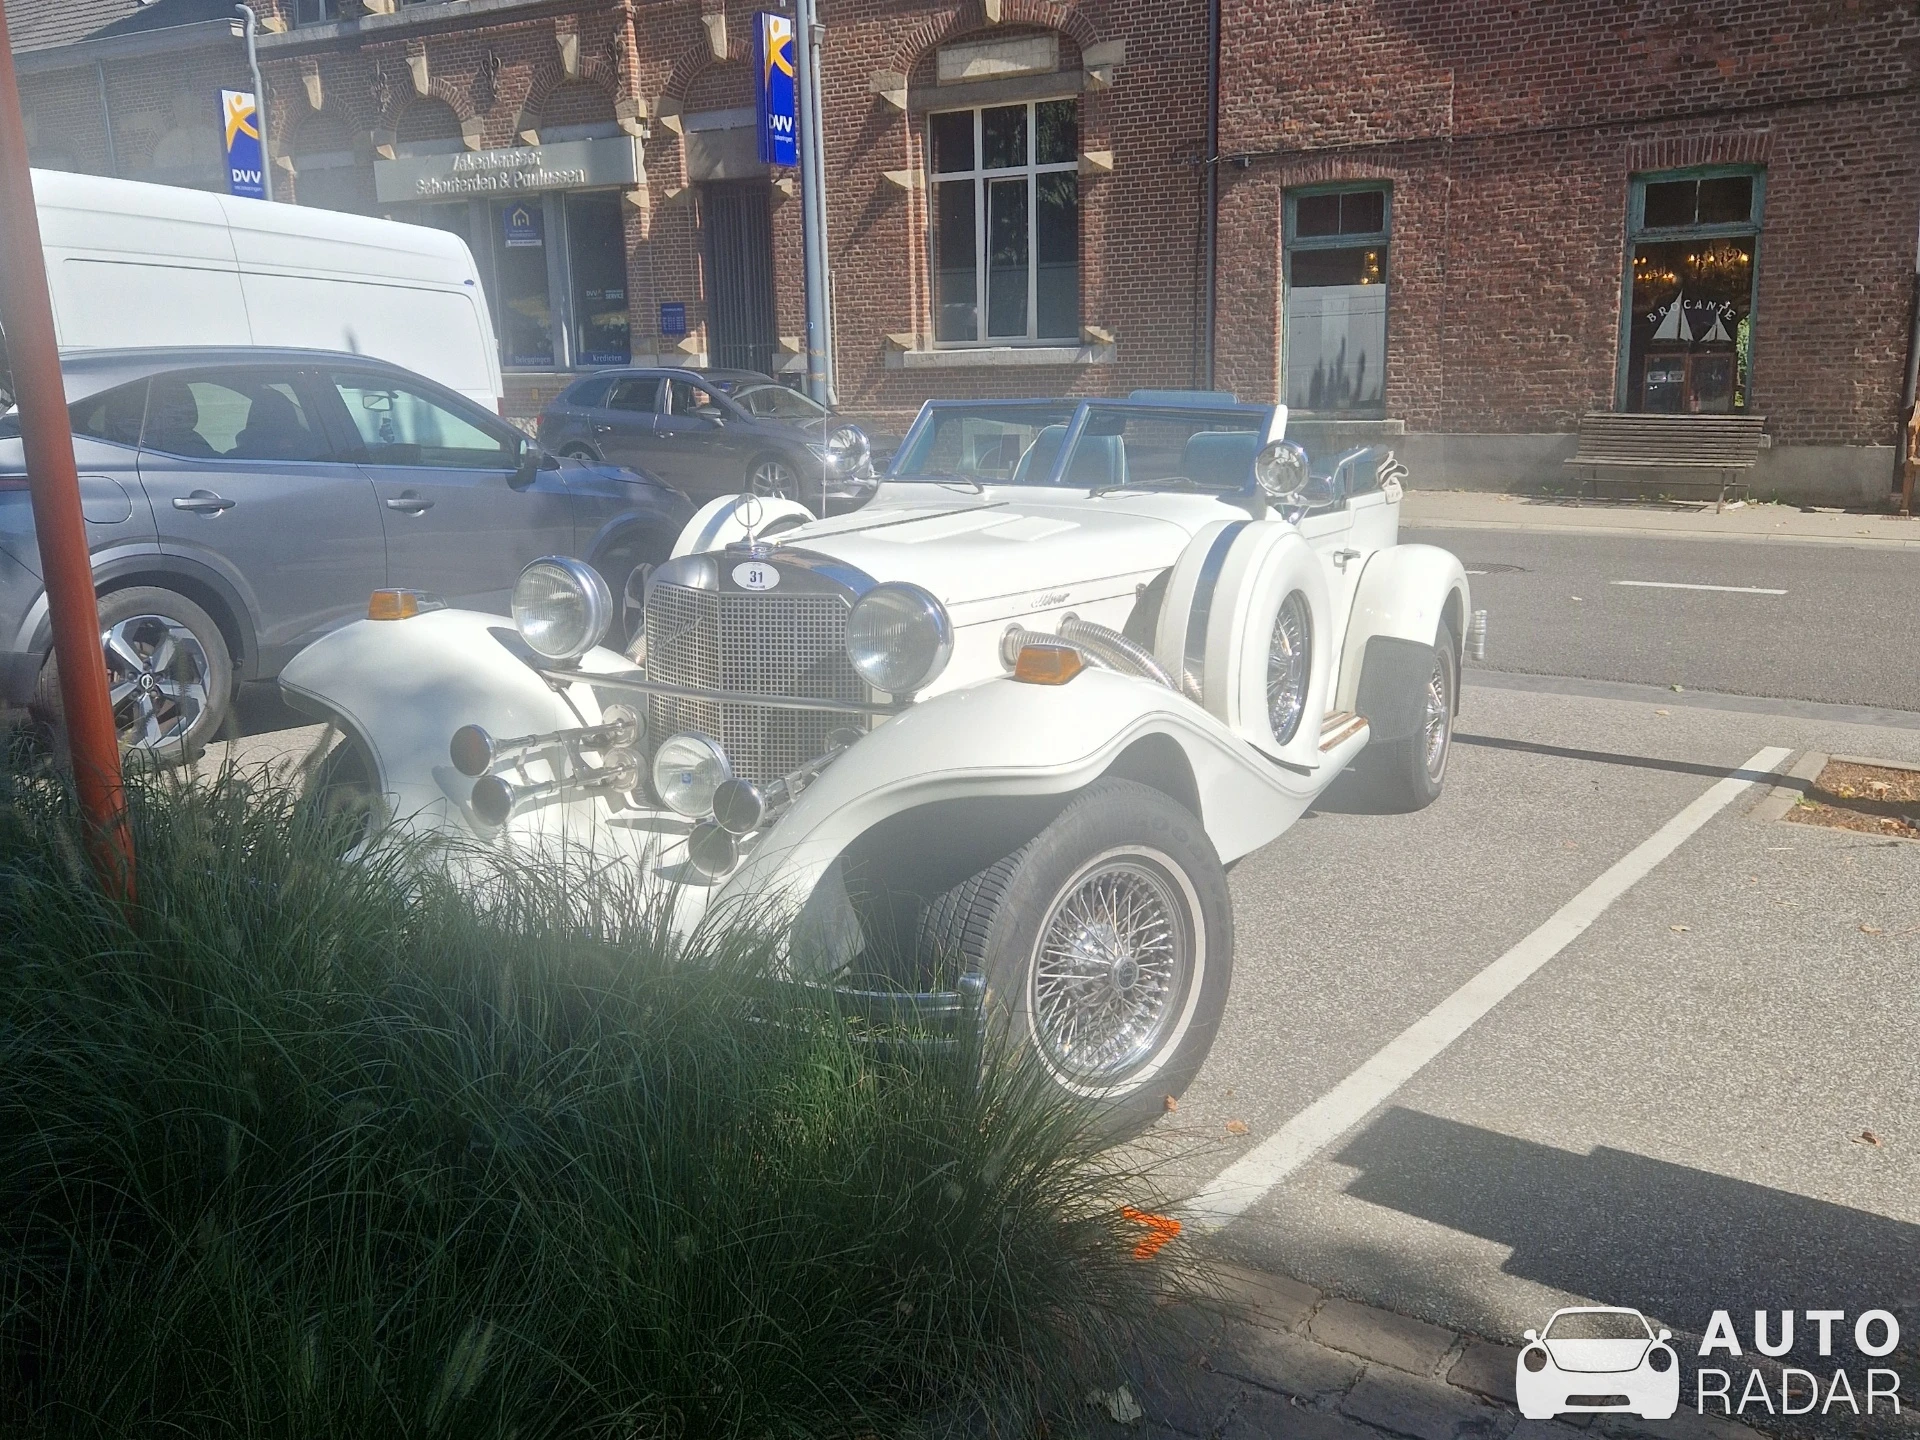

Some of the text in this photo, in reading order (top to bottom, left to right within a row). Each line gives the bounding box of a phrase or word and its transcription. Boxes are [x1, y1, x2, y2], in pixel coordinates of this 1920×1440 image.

[769, 113, 793, 133] DVV
[231, 168, 261, 184] DVV
[416, 167, 585, 195] Schouterden & Paulussen
[1646, 299, 1736, 323] BROCANTE
[749, 570, 763, 583] 31
